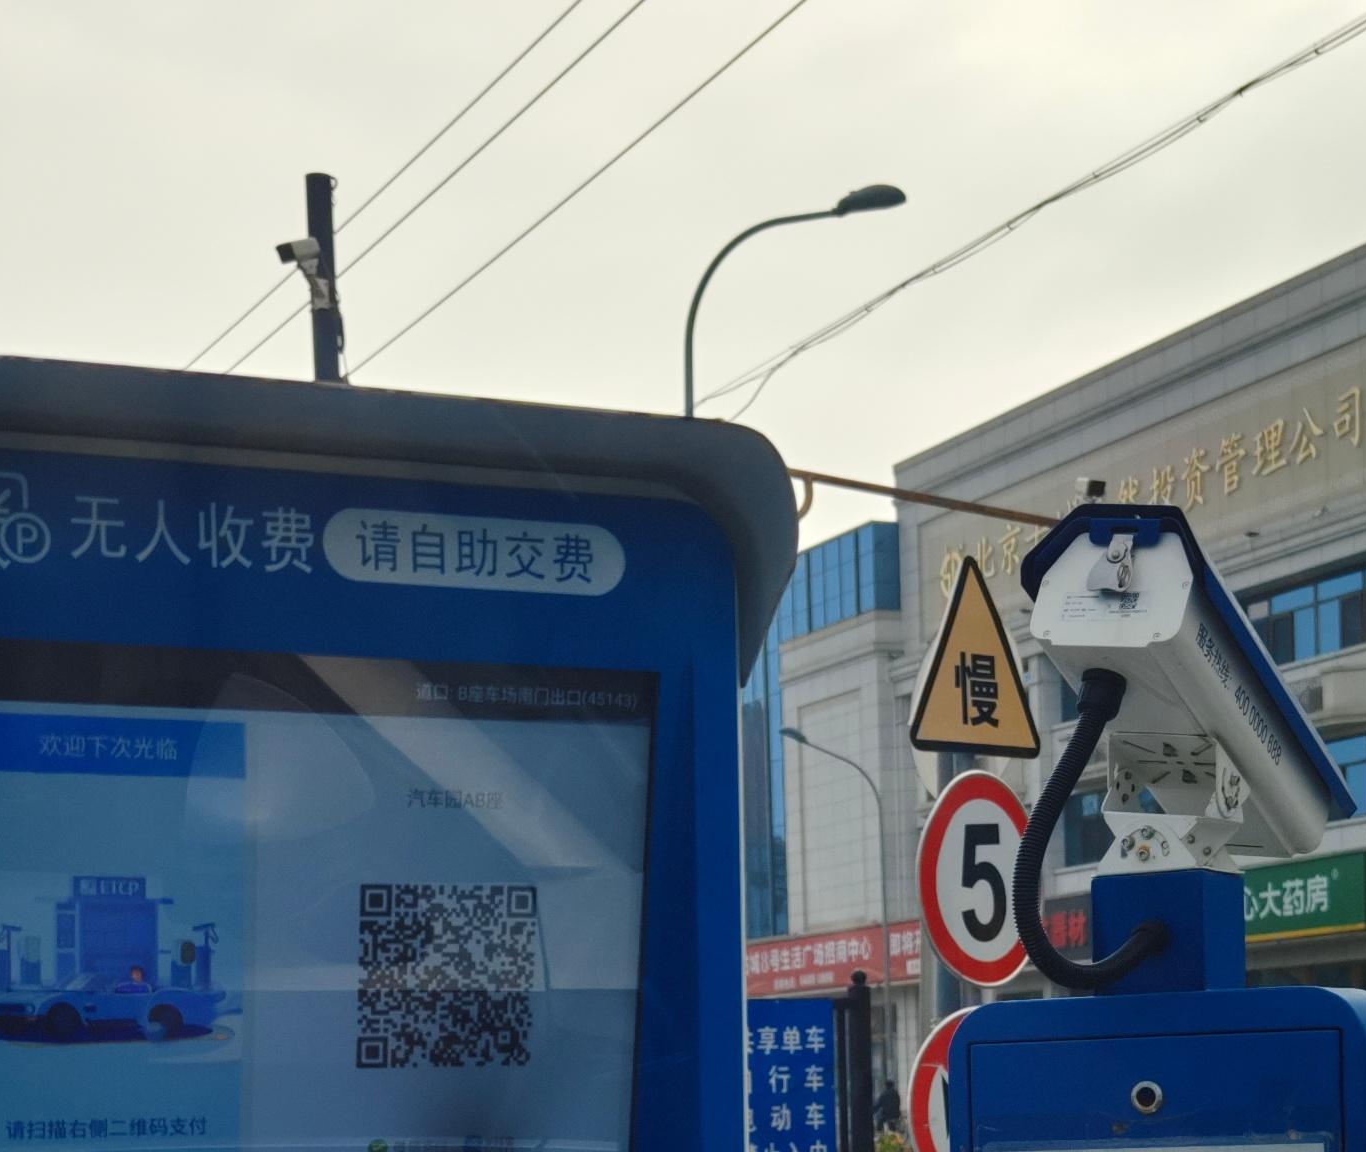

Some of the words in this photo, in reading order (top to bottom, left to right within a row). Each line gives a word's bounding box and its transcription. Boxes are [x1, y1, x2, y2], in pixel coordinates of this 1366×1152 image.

[975, 386, 1364, 579] 北京投资管理公司
[70, 494, 315, 575] 无人收费
[355, 518, 595, 586] 请自助交费
[955, 651, 1000, 727] 慢
[38, 735, 178, 762] 欢迎下次光临
[407, 787, 503, 811] 汽车园AB座
[962, 824, 1006, 942] 5
[6, 1117, 208, 1140] 请扫描右侧二维码支付
